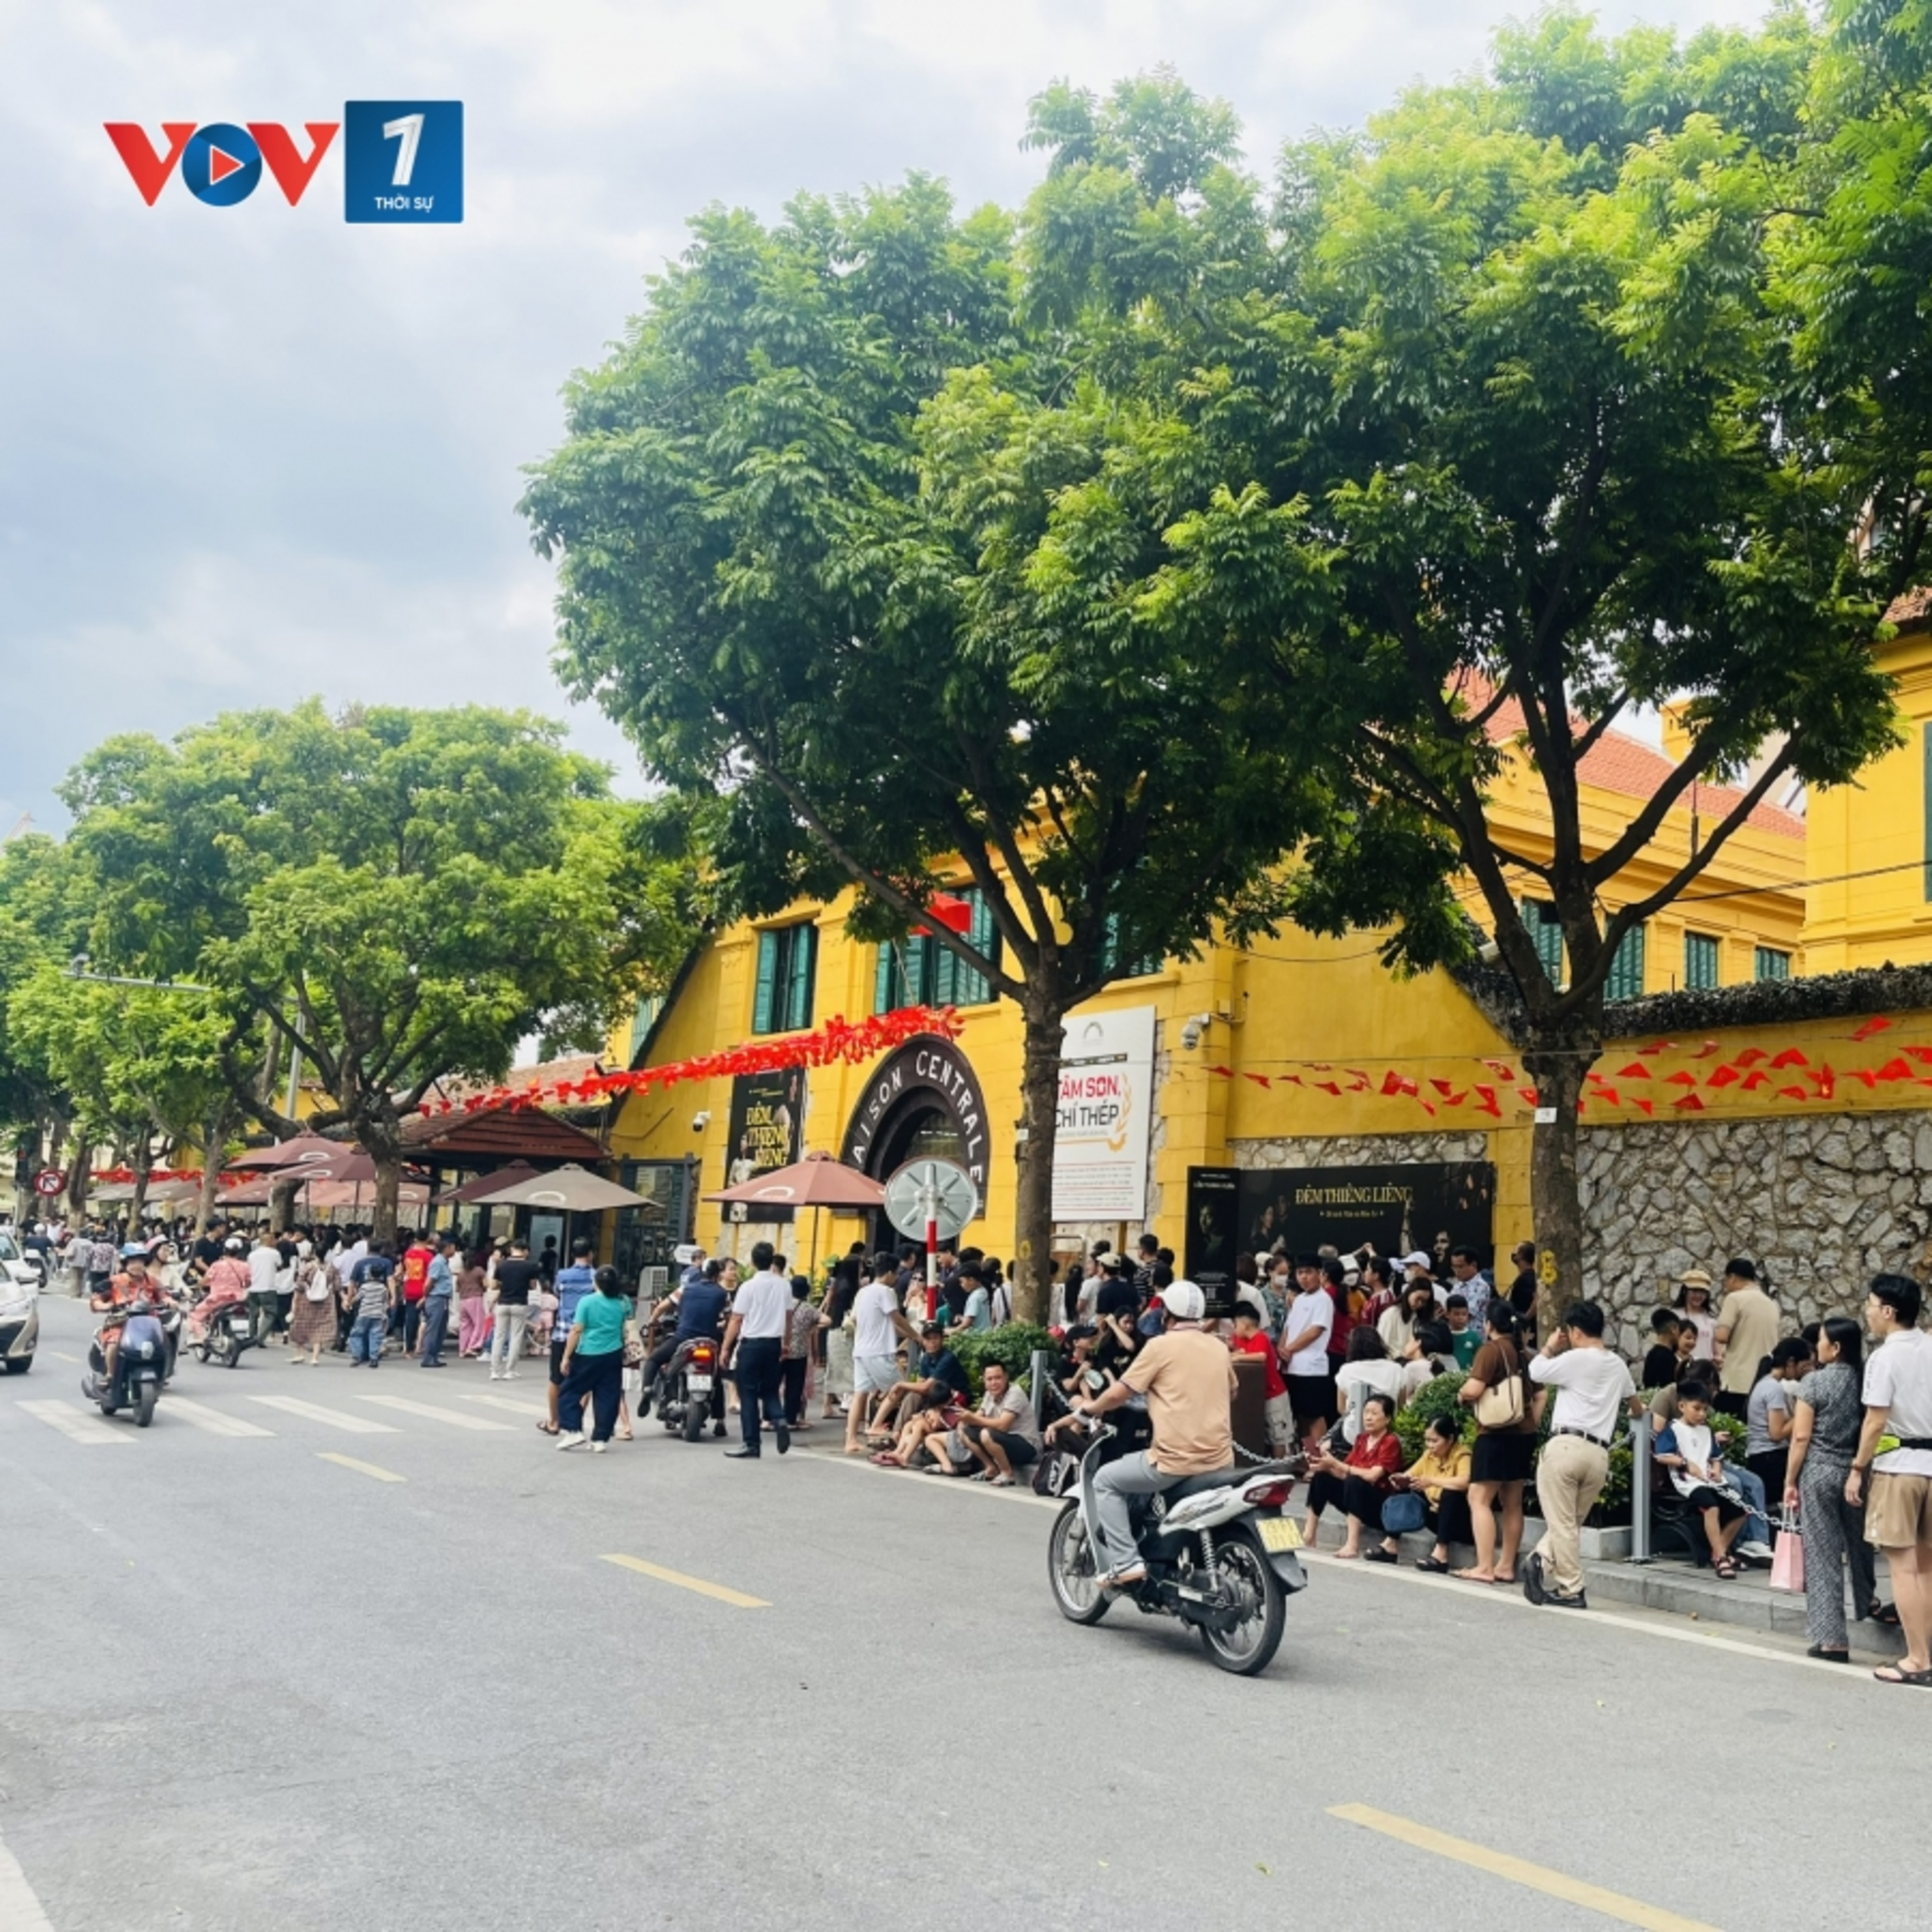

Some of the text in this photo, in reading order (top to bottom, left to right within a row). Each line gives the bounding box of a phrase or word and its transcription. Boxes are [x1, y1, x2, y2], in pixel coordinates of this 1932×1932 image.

[852, 1050, 982, 1183] AISON CENTRALE
[1079, 1099, 1119, 1126] THÉP
[1296, 1182, 1413, 1205] ĐÊM THIÊNG LIÊNG
